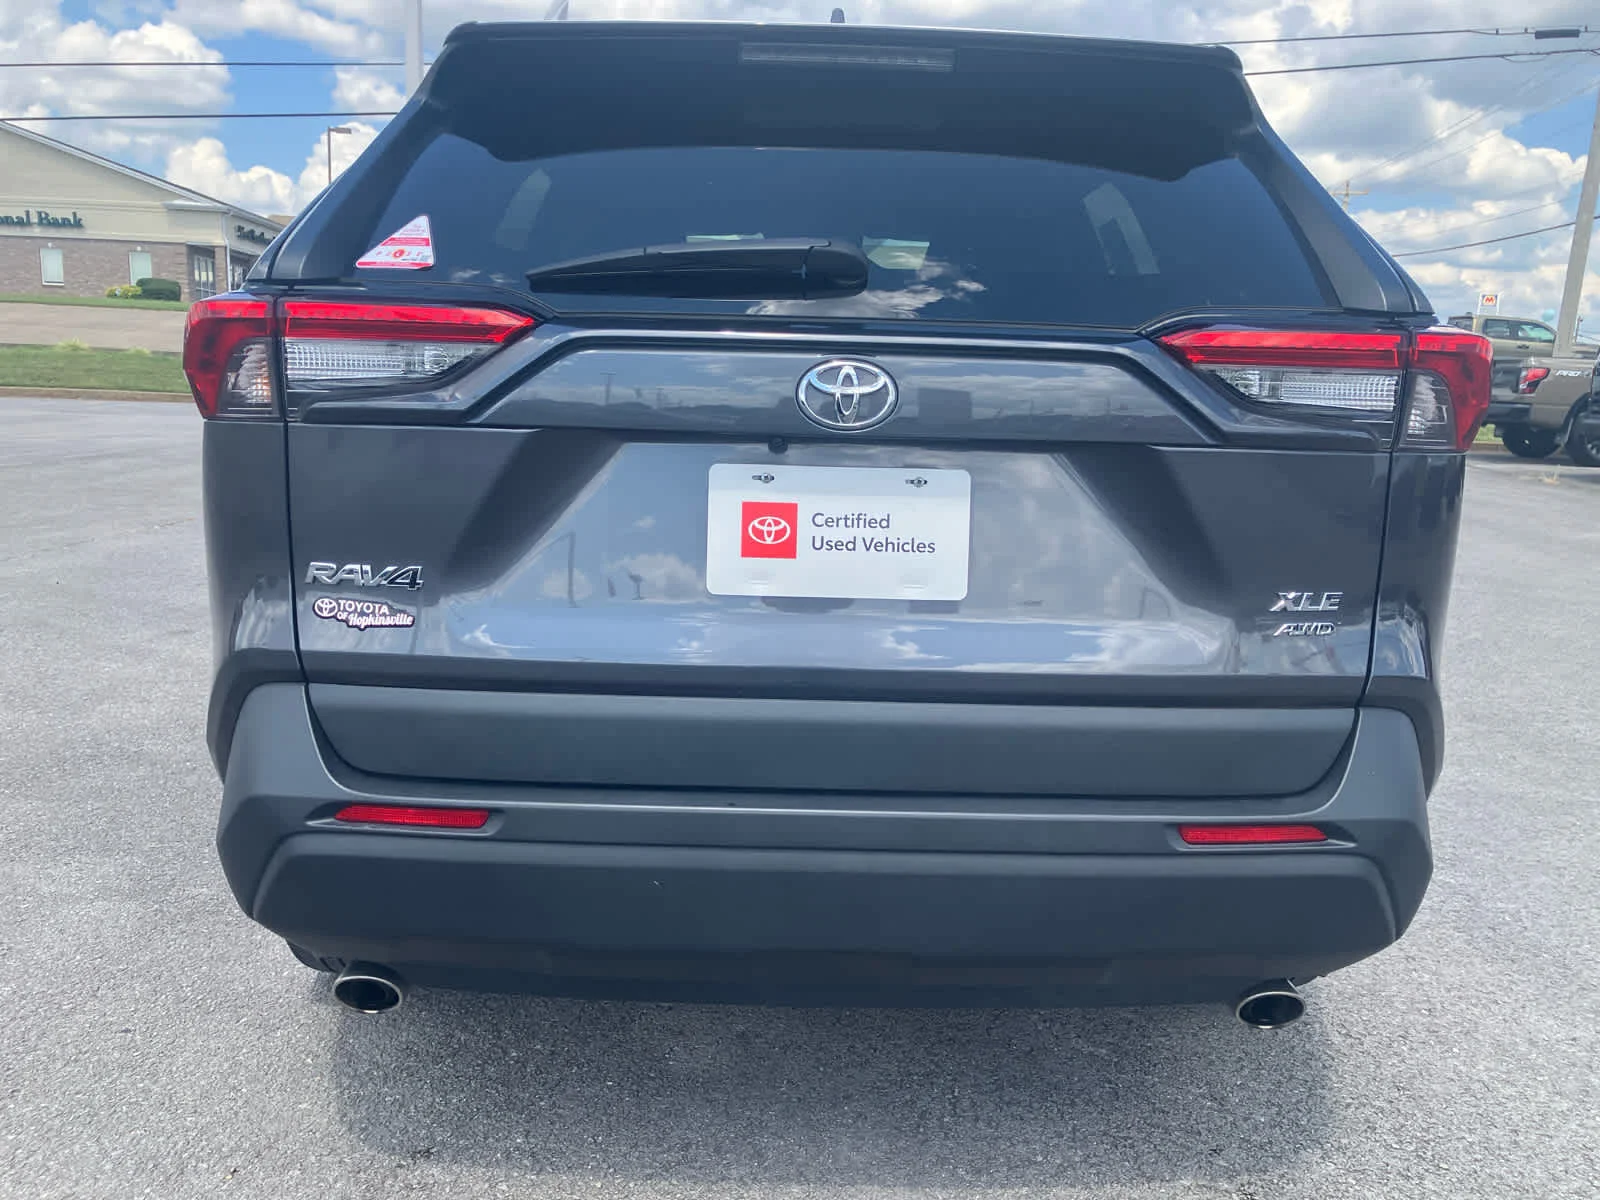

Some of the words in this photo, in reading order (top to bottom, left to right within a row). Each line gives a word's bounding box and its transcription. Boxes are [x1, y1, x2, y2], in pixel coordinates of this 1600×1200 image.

[36, 210, 84, 228] Bank
[811, 512, 891, 529] Certified
[811, 535, 857, 552] Used
[862, 537, 936, 554] Vehicles
[305, 561, 424, 591] RAV4
[338, 599, 389, 615] TOYOTA
[1269, 591, 1343, 611] XLE
[348, 612, 415, 629] Hopkinsville
[1273, 622, 1335, 637] AWD
